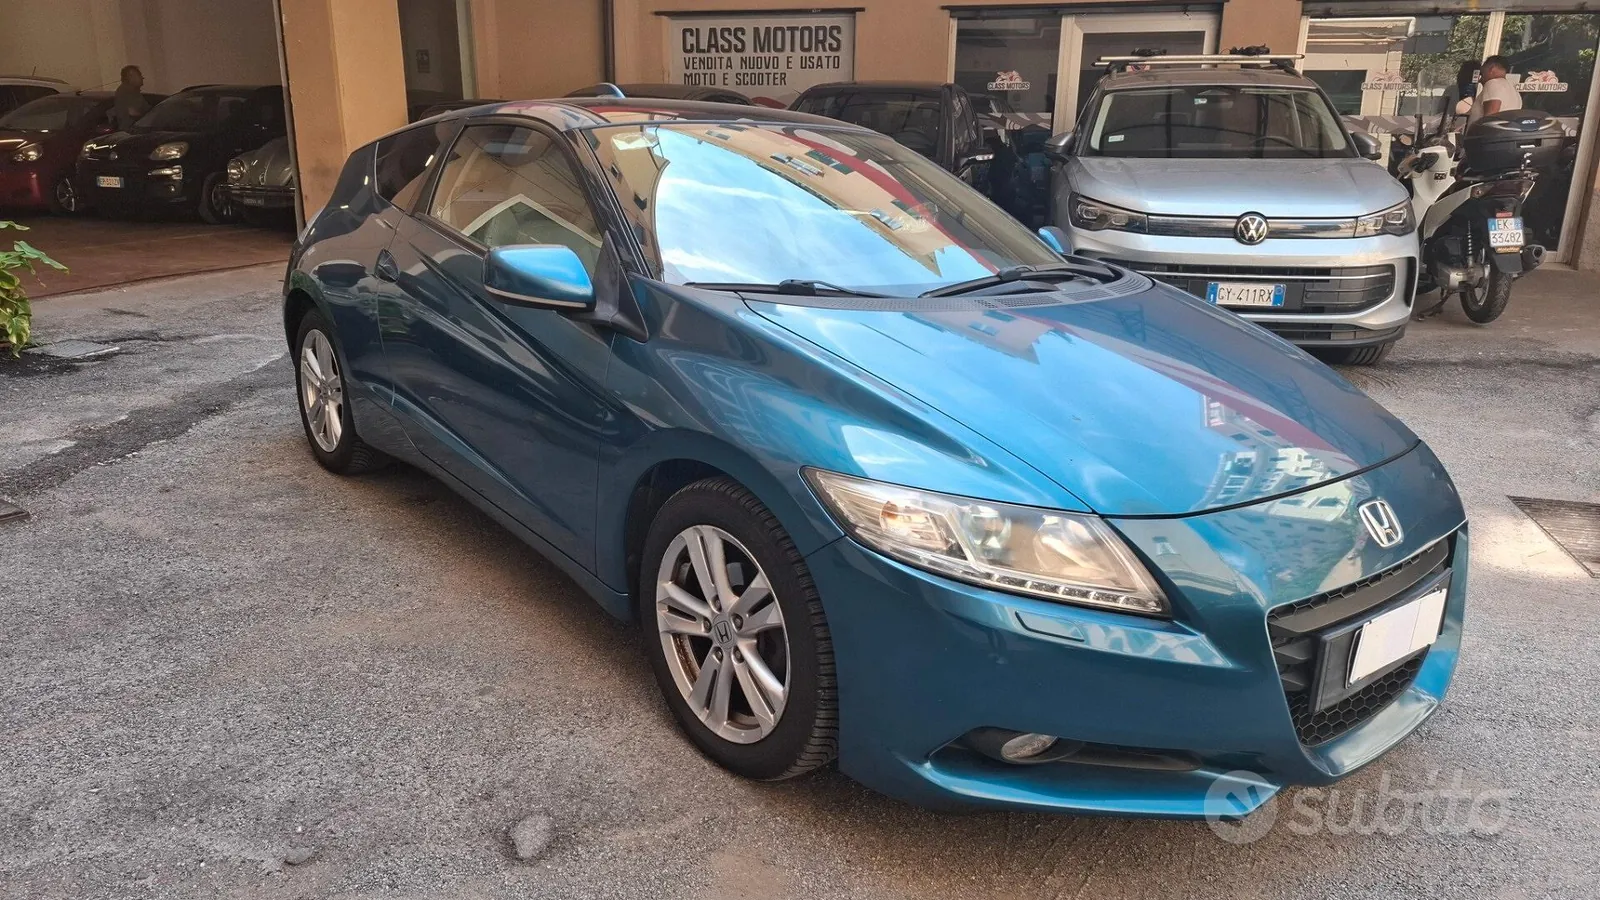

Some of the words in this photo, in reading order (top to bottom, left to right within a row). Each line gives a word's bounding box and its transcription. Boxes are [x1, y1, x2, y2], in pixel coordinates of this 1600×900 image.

[682, 27, 746, 53] CLASS
[753, 25, 842, 53] MOTORS
[683, 56, 733, 70] VENDITA
[740, 56, 779, 70] NUOVO
[786, 56, 793, 70] E
[800, 55, 840, 70] USATO
[683, 72, 716, 86] MOTO
[723, 72, 729, 86] E
[735, 72, 787, 86] SCOOTER
[1361, 82, 1382, 90] CLASS
[1383, 82, 1411, 90] MOTORS
[1515, 83, 1536, 91] CLASS
[1538, 83, 1567, 91] MOTORS
[1491, 232, 1522, 243] 33482
